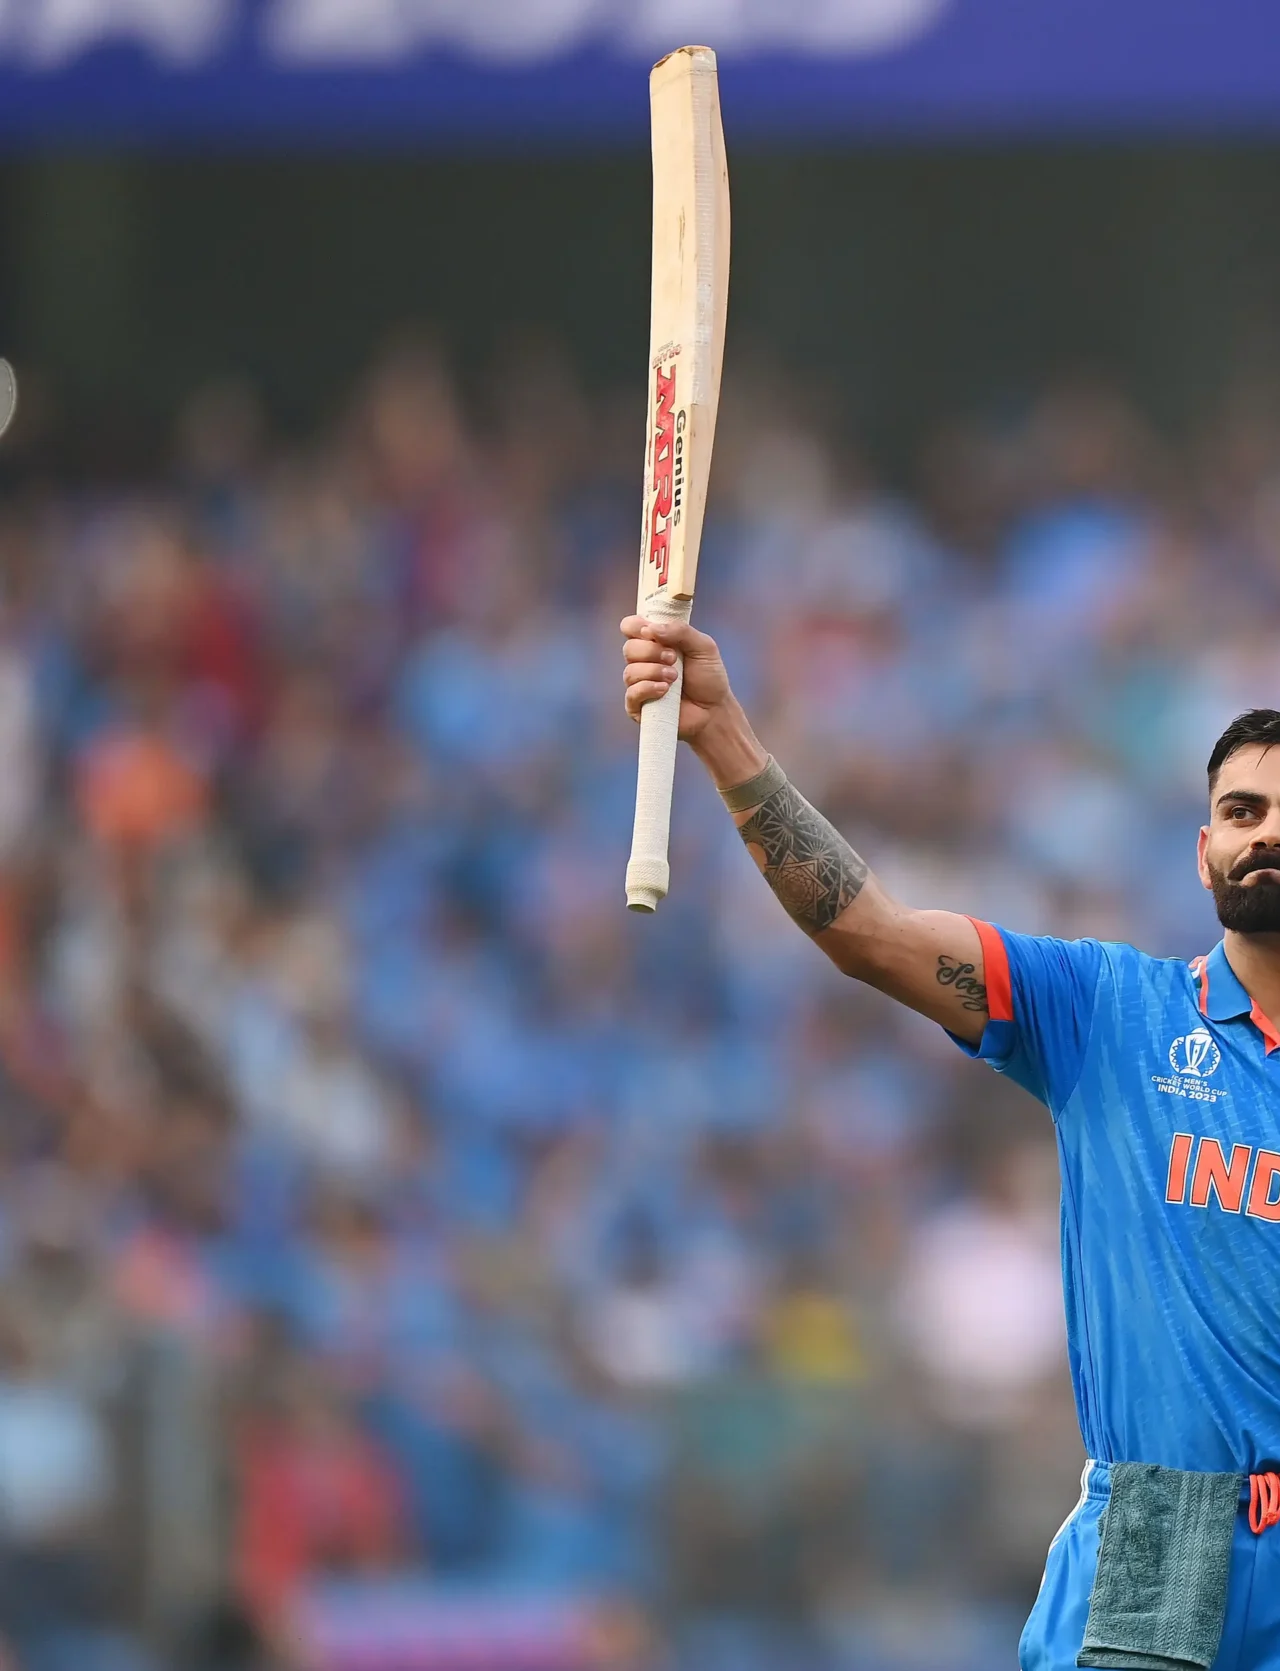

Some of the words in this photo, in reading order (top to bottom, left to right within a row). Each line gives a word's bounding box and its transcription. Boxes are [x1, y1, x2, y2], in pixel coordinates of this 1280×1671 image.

[650, 365, 677, 588] MRF
[674, 409, 687, 527] Genius
[1151, 1075, 1182, 1087] CRICKET
[1183, 1083, 1211, 1093] WORLD
[1211, 1088, 1228, 1097] CUP
[1171, 1074, 1184, 1083] ICC
[1184, 1077, 1208, 1087] MEN'S
[1157, 1083, 1187, 1097] INDIA
[1188, 1091, 1217, 1103] 2023
